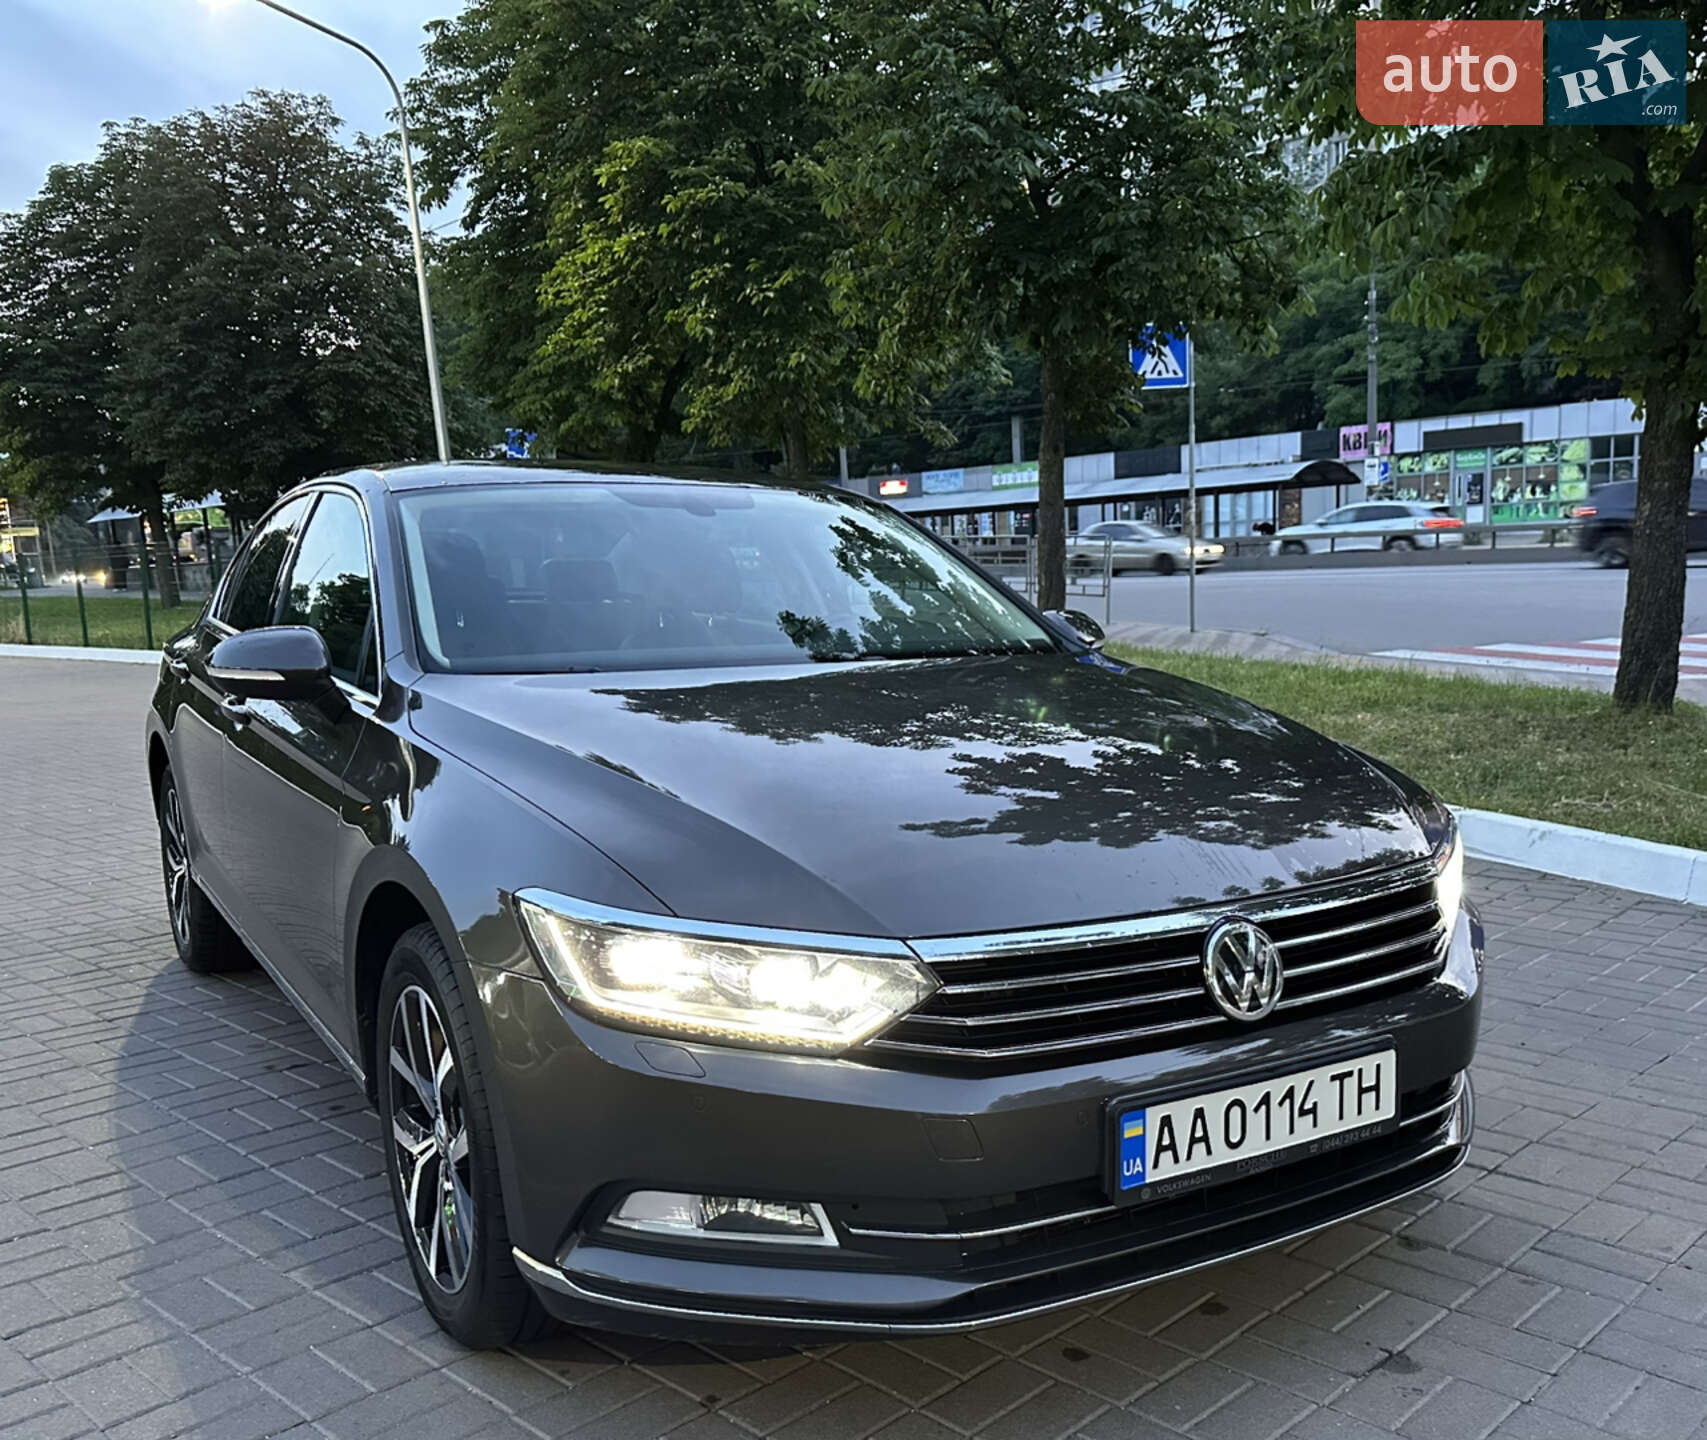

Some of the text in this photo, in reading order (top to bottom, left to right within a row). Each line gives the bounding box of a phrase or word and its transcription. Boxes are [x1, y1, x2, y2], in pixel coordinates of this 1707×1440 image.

[1152, 1062, 1382, 1170] AA 0114 TH
[1122, 1155, 1144, 1177] UA
